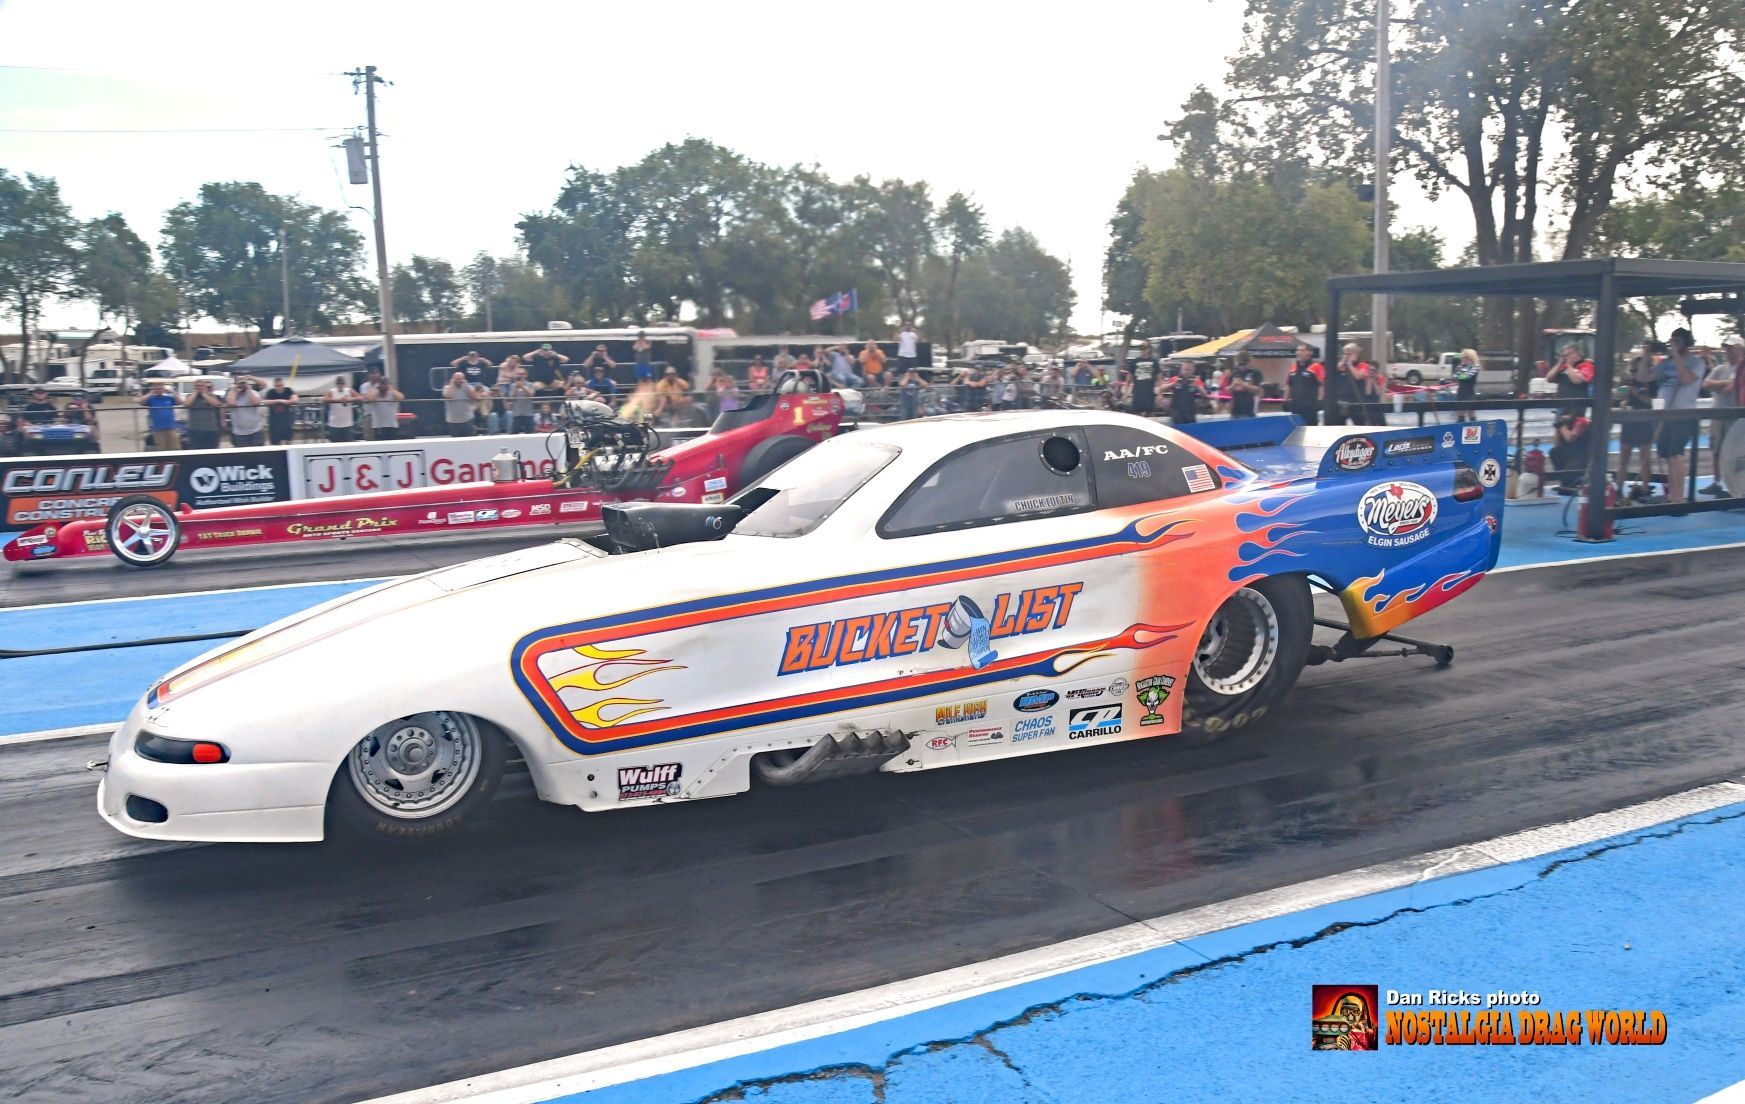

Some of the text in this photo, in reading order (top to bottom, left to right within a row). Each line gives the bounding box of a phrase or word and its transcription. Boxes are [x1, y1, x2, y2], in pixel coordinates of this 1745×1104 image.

[794, 407, 805, 425] 1
[1103, 444, 1169, 461] AA/FC
[216, 464, 274, 481] Wick
[319, 465, 335, 493] J
[355, 463, 378, 491] &
[397, 461, 413, 489] J
[1127, 460, 1151, 478] 419
[3, 463, 175, 493] CONLEY
[220, 481, 275, 493] Buildings
[1014, 494, 1074, 511] CHUCK LOFTIN
[1365, 495, 1431, 534] Meyers
[287, 517, 398, 535] Grand Prix
[1368, 528, 1430, 547] ELGIN SAUSAGE
[777, 581, 1084, 677] BUCKET LIST
[1015, 715, 1053, 732] CHAOS
[1012, 730, 1038, 742] SUPER
[1039, 727, 1056, 738] FAN
[1069, 725, 1122, 740] CARRILLO
[931, 739, 948, 748] RFC
[619, 764, 678, 785] Wulff
[621, 782, 666, 792] PUMPS
